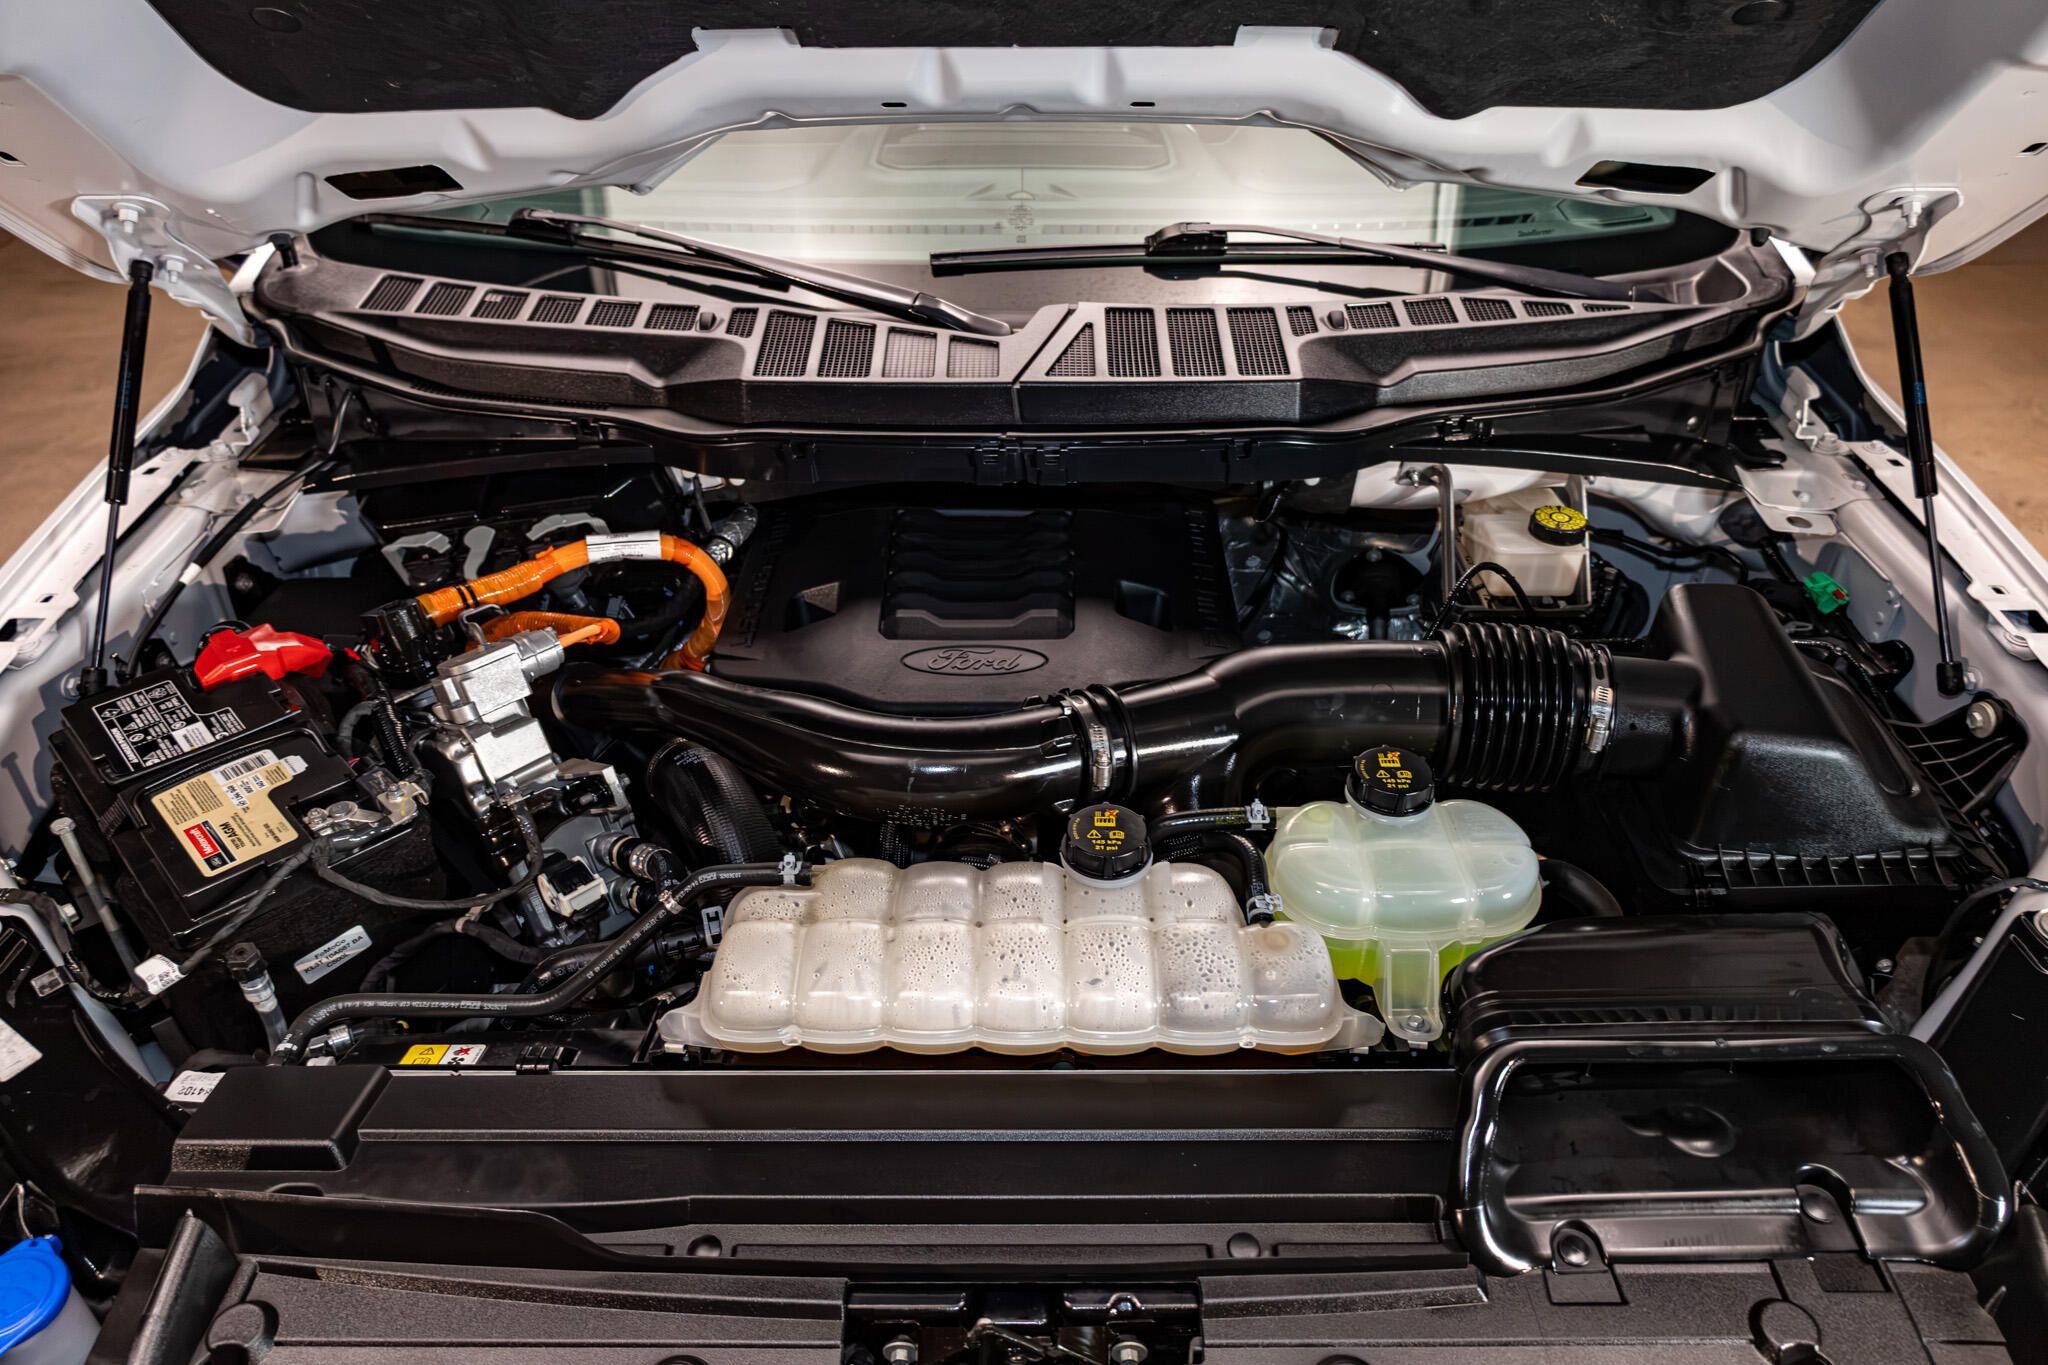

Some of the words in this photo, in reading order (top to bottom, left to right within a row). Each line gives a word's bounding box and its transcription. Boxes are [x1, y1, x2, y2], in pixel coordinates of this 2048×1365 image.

[928, 649, 1023, 671] Ford
[189, 826, 214, 854] Motorcraft
[218, 821, 238, 839] AGM
[314, 939, 346, 958] FoMoCo
